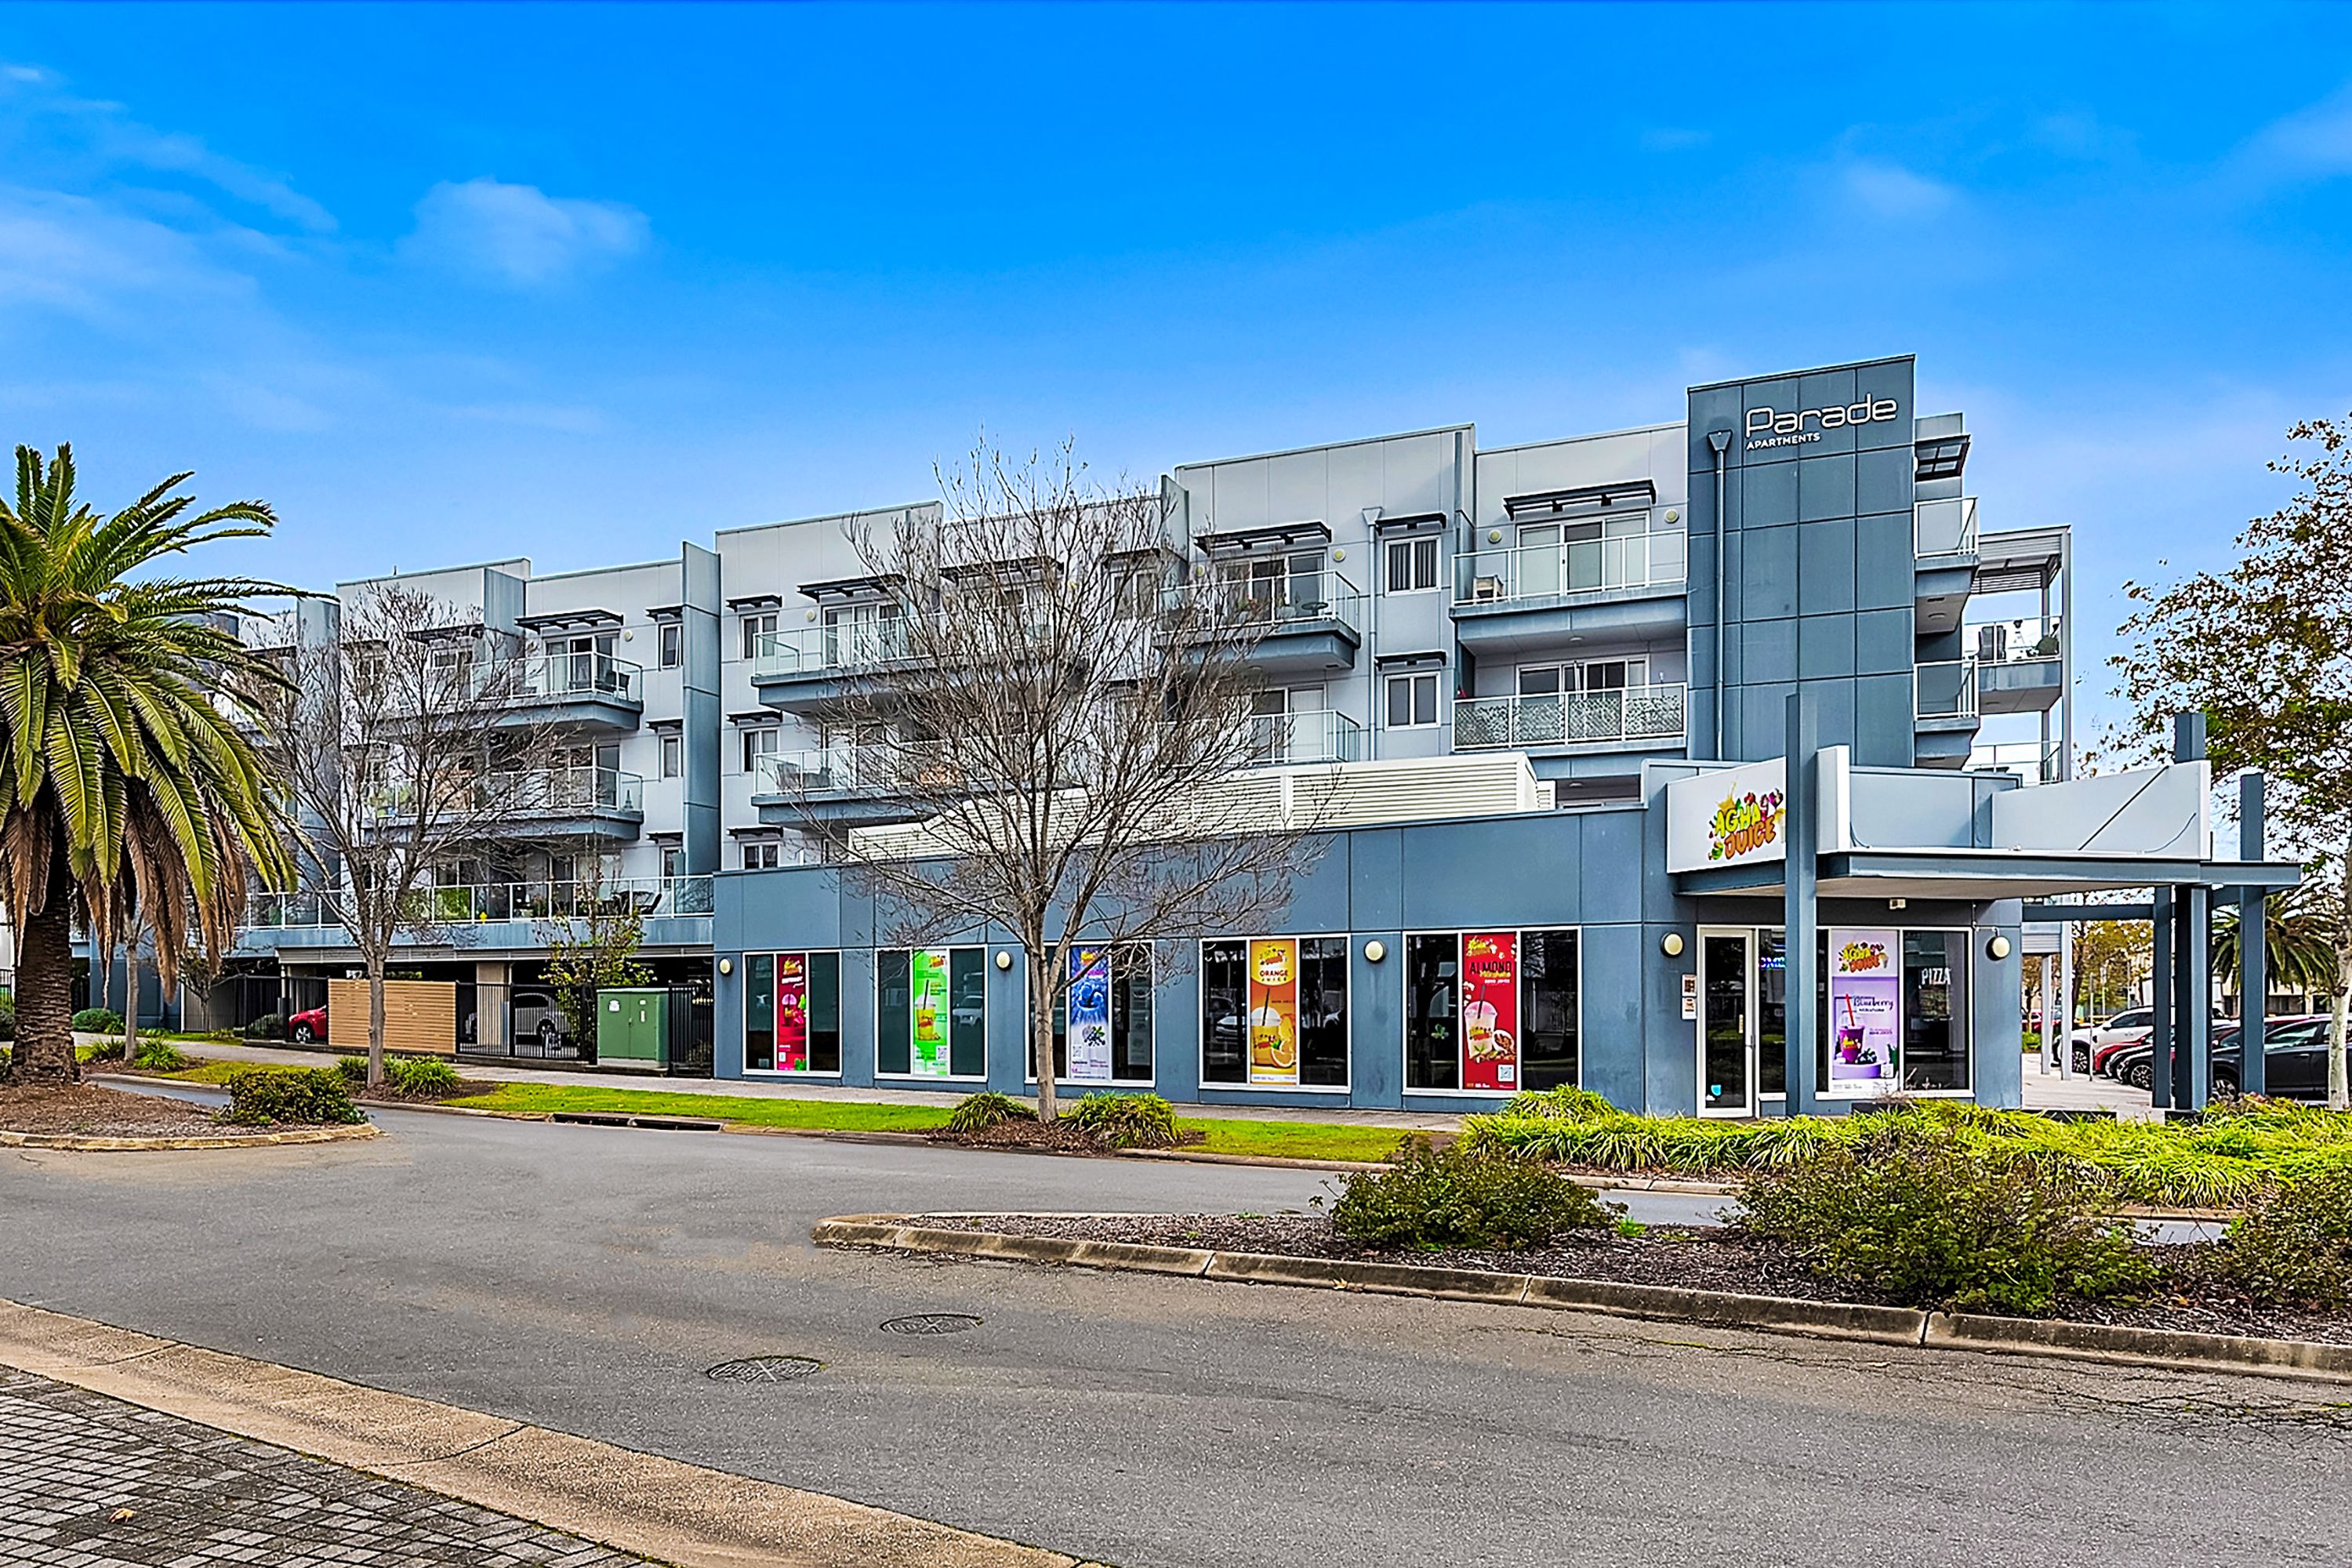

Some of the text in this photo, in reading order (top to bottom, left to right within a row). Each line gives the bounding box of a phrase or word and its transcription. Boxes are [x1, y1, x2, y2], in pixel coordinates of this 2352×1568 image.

[1745, 393, 1897, 437] Parade
[1746, 431, 1821, 451] APARTMENTS
[1715, 802, 1761, 838] AGHA
[1724, 815, 1777, 860] JUICE
[1259, 969, 1288, 978] ORANGE
[1469, 960, 1512, 975] ALMOND
[1922, 967, 1951, 985] PIZZA
[1853, 996, 1894, 1011] Blueberry
